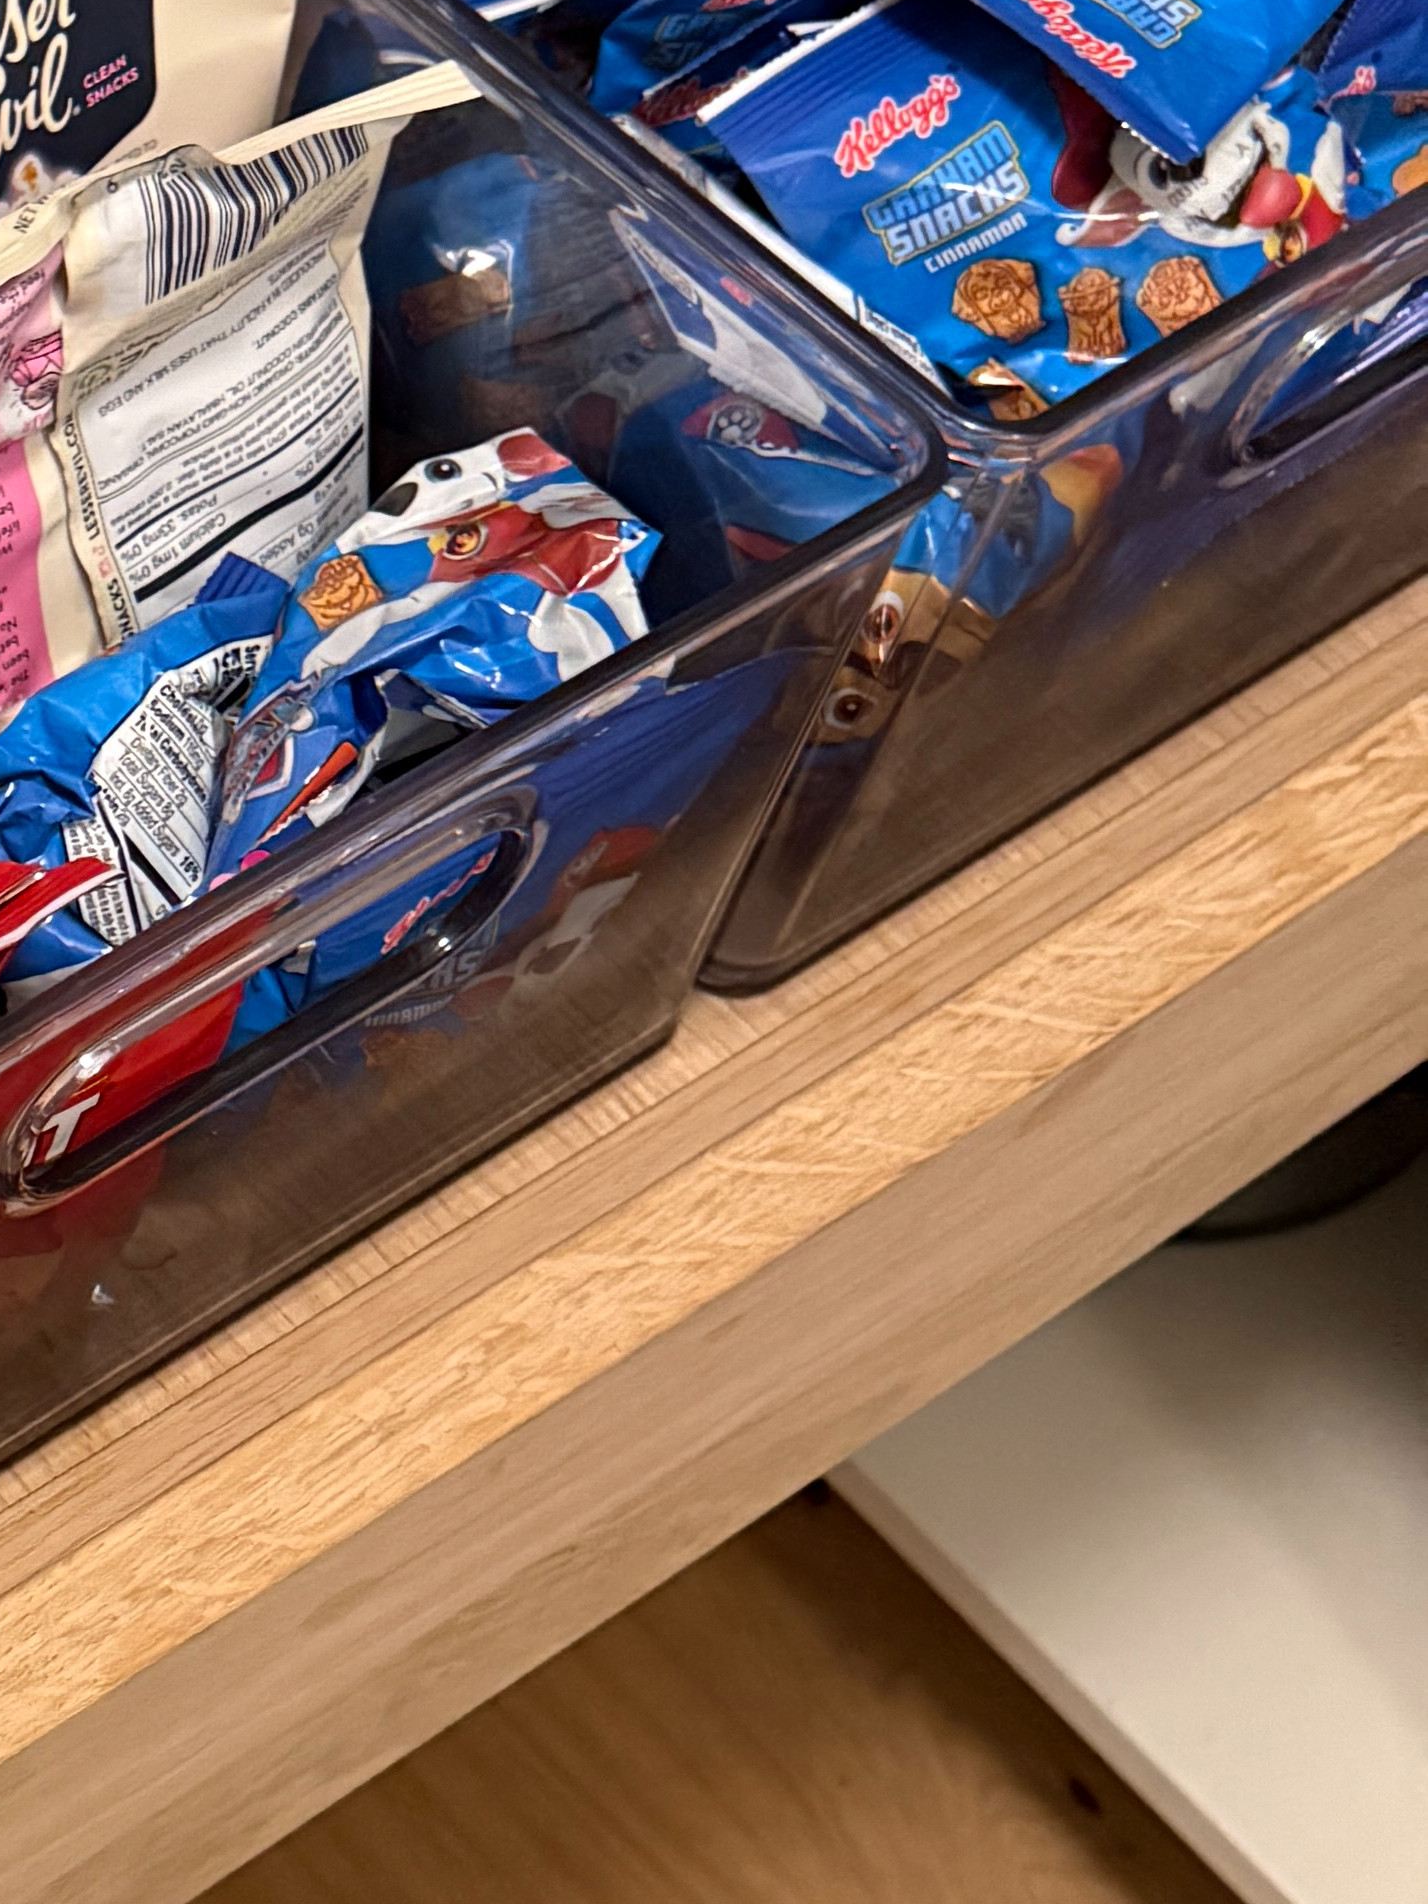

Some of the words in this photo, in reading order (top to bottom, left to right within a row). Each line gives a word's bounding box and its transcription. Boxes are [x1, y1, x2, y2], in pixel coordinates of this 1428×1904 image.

[81, 53, 129, 91] CLEAN
[84, 66, 141, 110] SNACKS
[833, 73, 960, 177] Kellogg's
[868, 127, 1018, 231] GRAHAM
[886, 162, 1030, 263] SNACKS
[175, 509, 229, 552] Calcium
[146, 697, 187, 742] Sodium
[134, 771, 165, 810] Sugars
